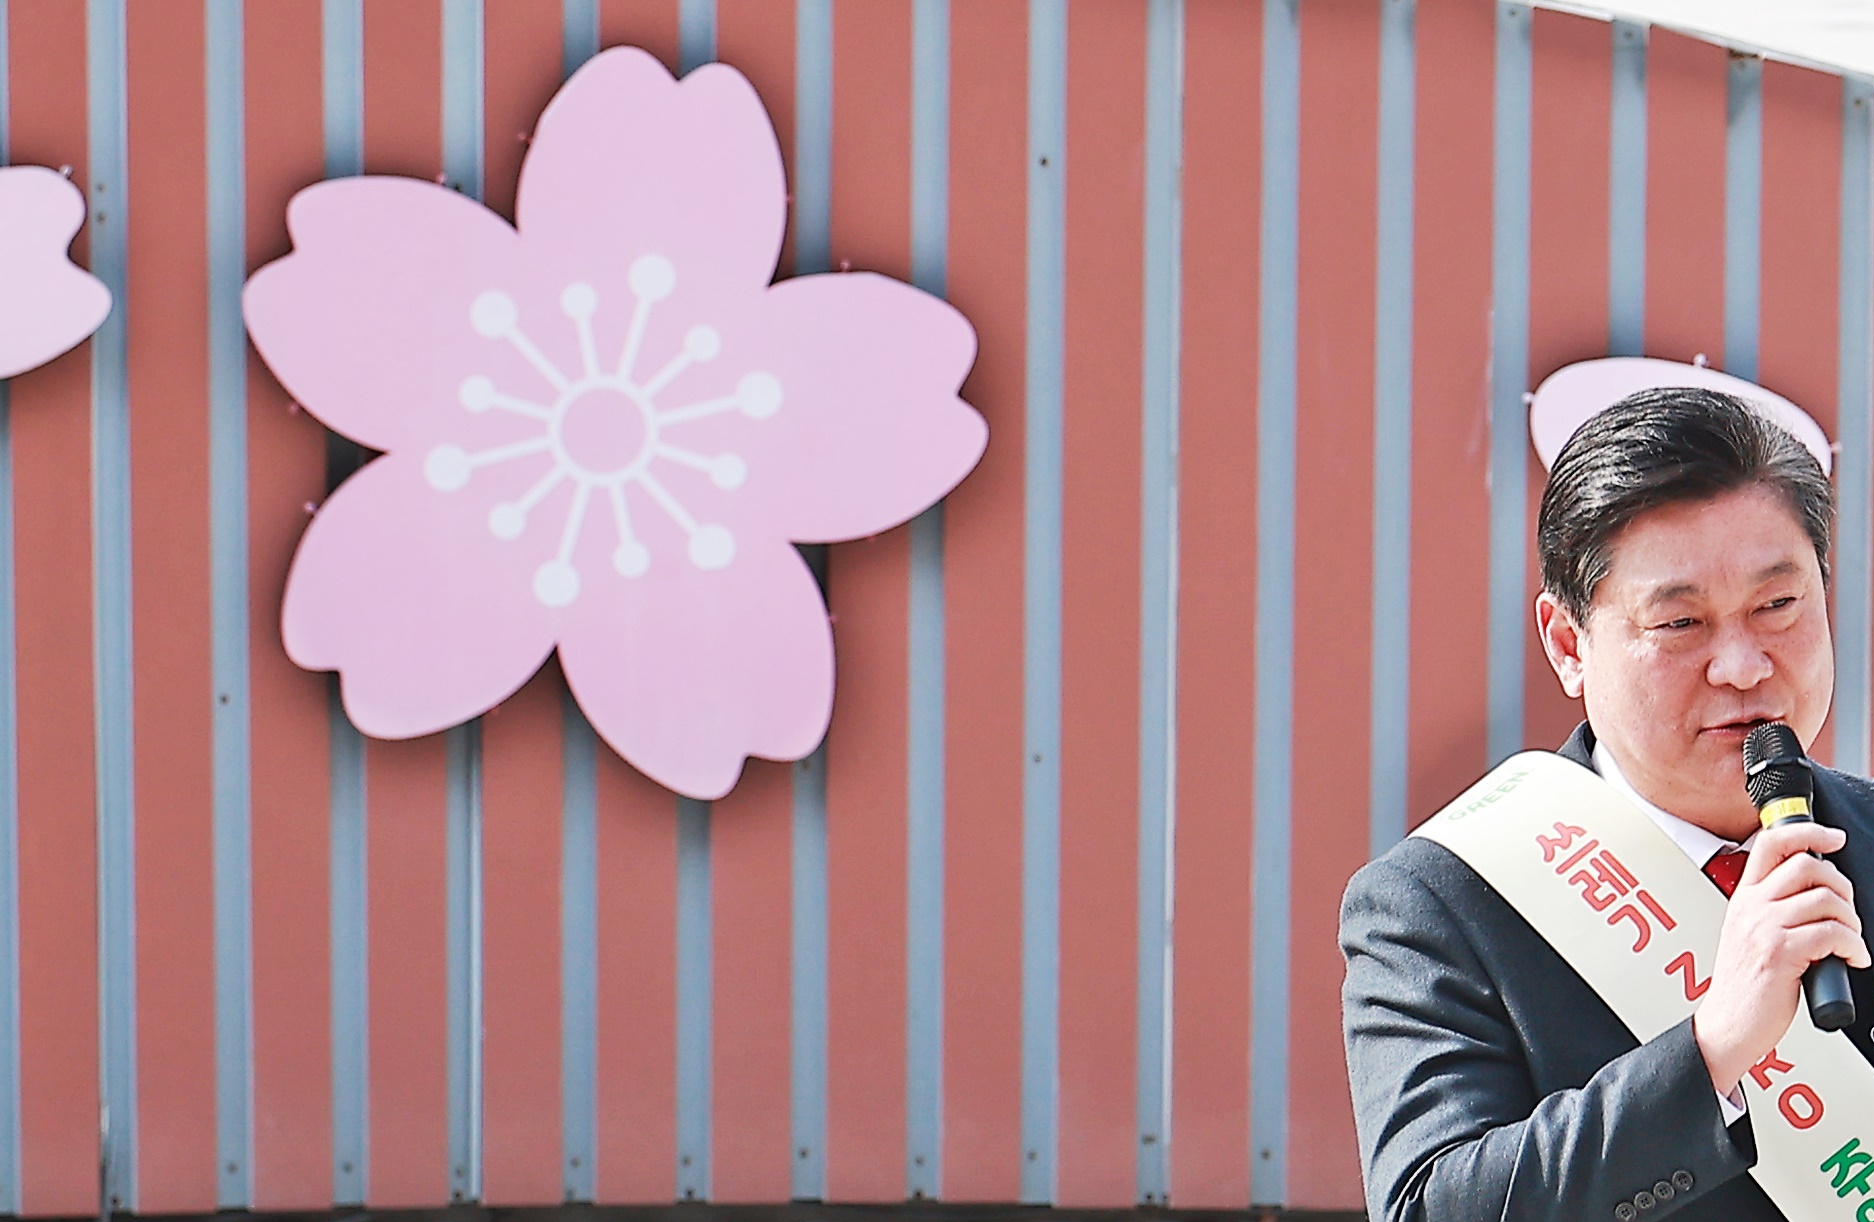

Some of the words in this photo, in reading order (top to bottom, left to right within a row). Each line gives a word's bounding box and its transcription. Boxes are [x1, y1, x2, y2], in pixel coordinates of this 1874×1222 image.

[1447, 770, 1530, 821] GREEN
[1535, 821, 1678, 953] 쓰레기
[1663, 950, 1825, 1130] ZRO
